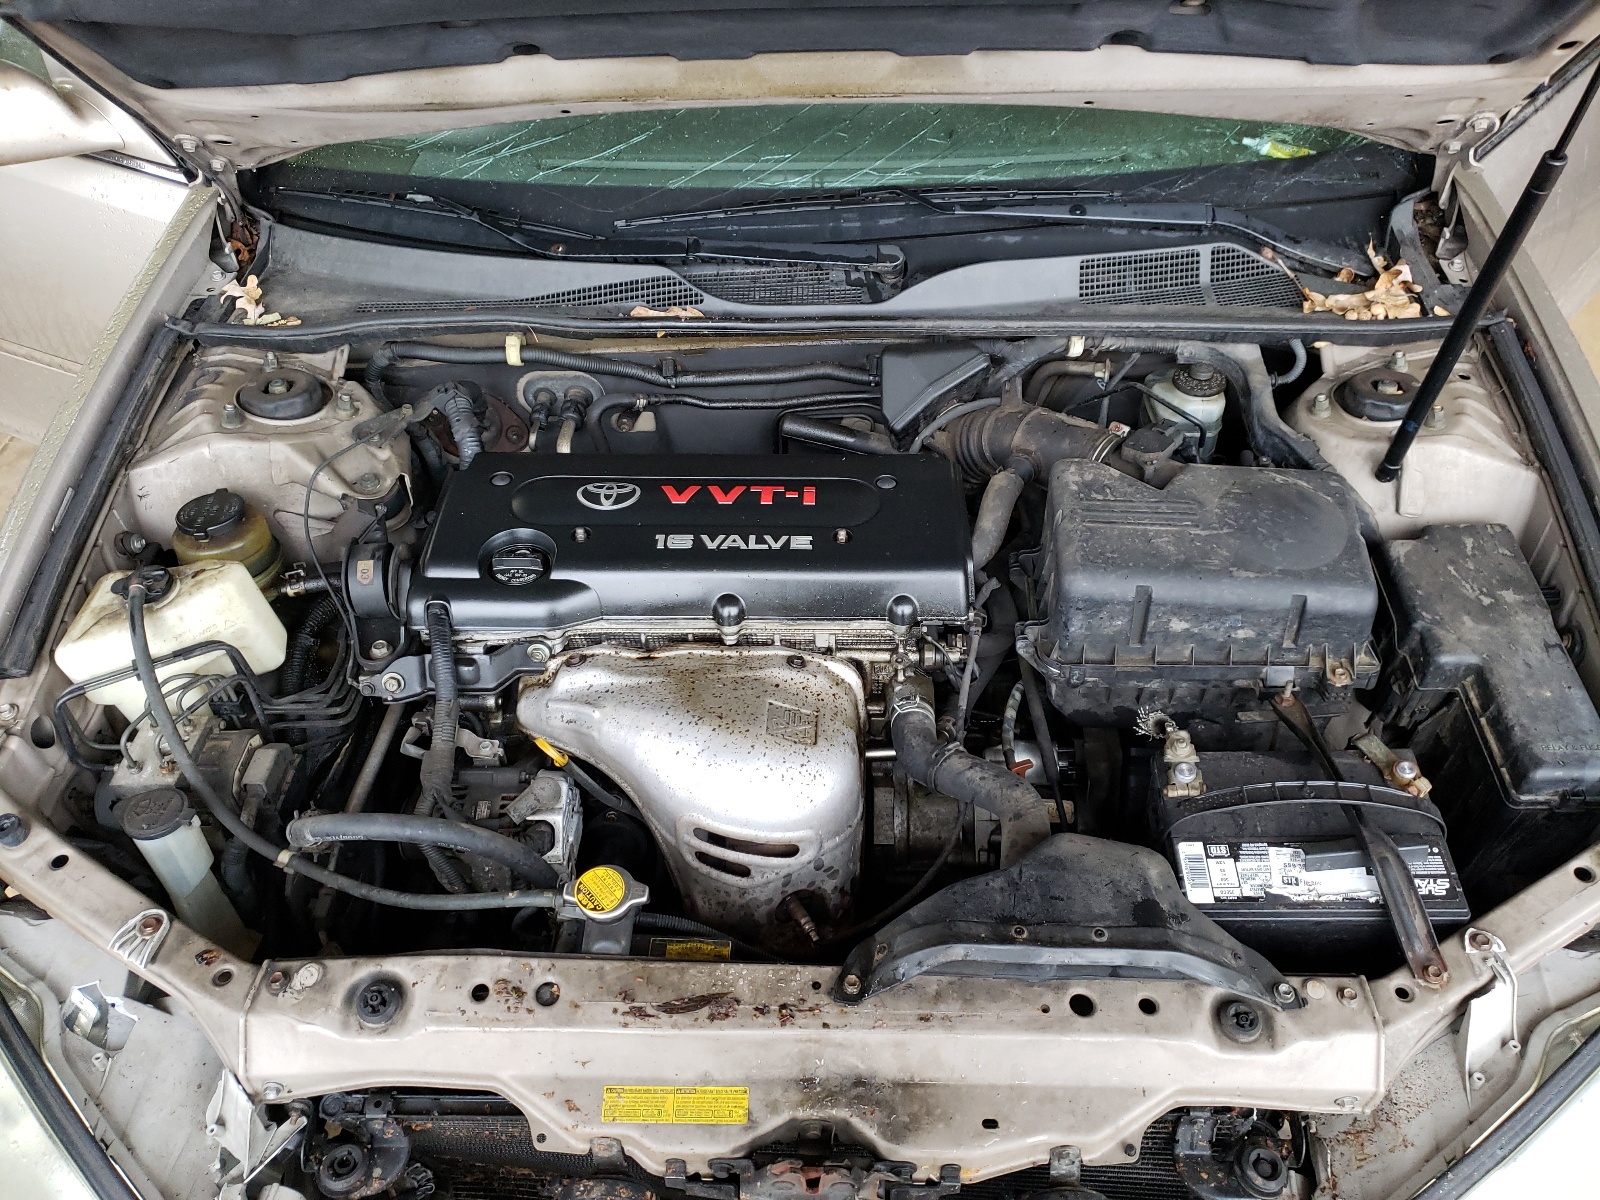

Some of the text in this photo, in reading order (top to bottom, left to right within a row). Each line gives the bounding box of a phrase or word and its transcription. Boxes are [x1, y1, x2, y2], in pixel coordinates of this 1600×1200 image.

[660, 485, 816, 506] VVT-i
[655, 534, 813, 550] 16 VALVE
[1413, 878, 1450, 890] STA
[1417, 887, 1447, 896] SUP
[578, 883, 603, 910] CAUTION
